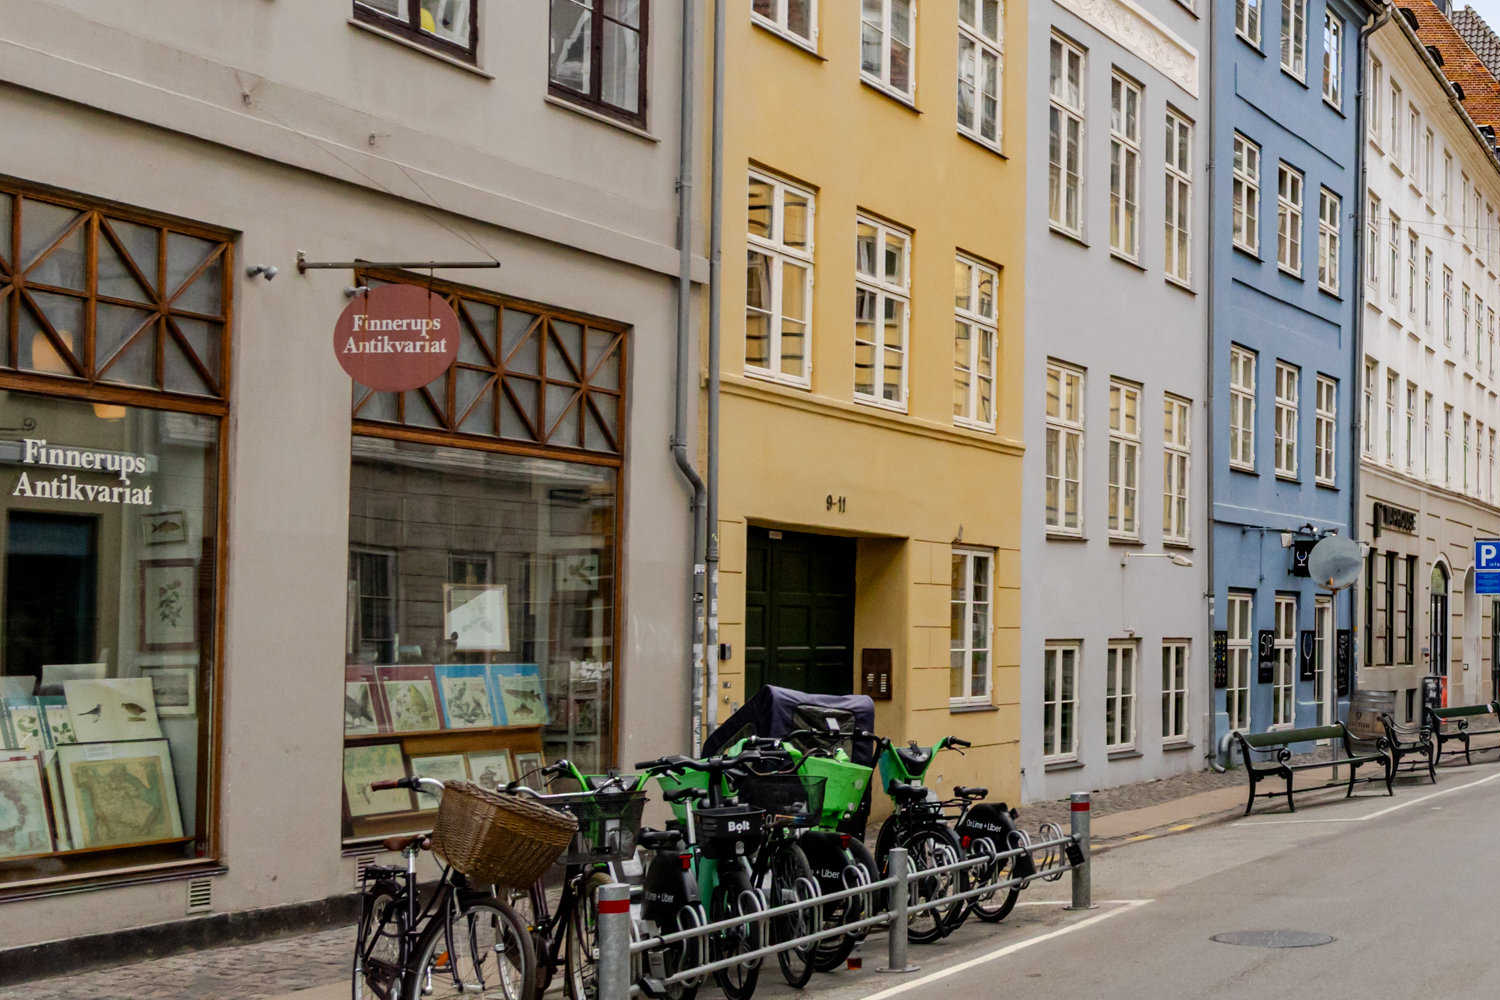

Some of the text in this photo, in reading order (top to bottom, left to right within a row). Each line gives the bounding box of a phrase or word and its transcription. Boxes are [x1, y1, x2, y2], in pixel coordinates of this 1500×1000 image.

[352, 314, 441, 337] Finnerups
[343, 336, 447, 354] Antikvariat
[23, 438, 146, 481] Finnerups
[12, 471, 153, 506] Antikvariat
[826, 494, 846, 514] 9-11
[1481, 545, 1497, 567] P
[728, 820, 750, 833] Bolt
[821, 868, 840, 879] Uber
[661, 892, 674, 903] Uber
